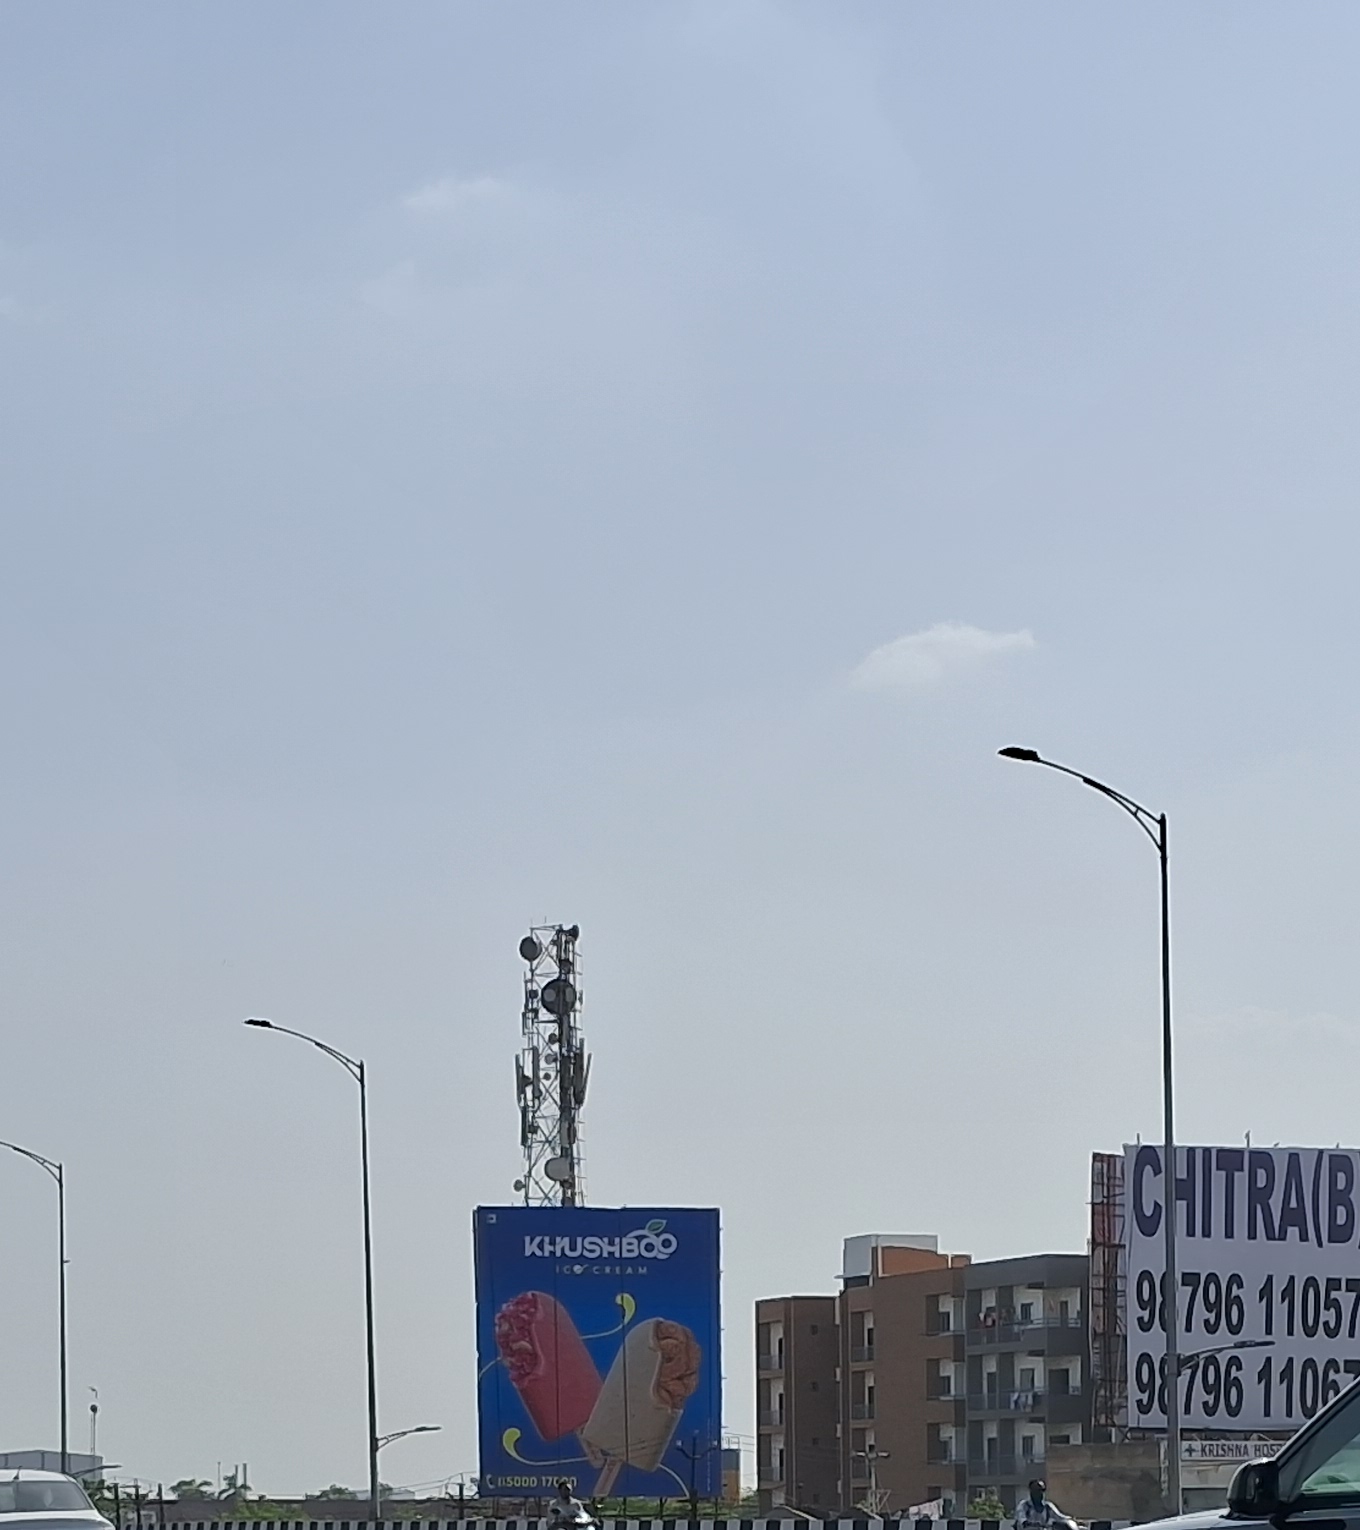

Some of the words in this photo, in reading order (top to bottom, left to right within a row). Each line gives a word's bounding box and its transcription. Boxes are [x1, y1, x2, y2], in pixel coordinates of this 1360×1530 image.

[524, 1230, 678, 1260] KHUSHBOO
[592, 1265, 648, 1275] CREAM
[1200, 1443, 1250, 1458] KRISHNA
